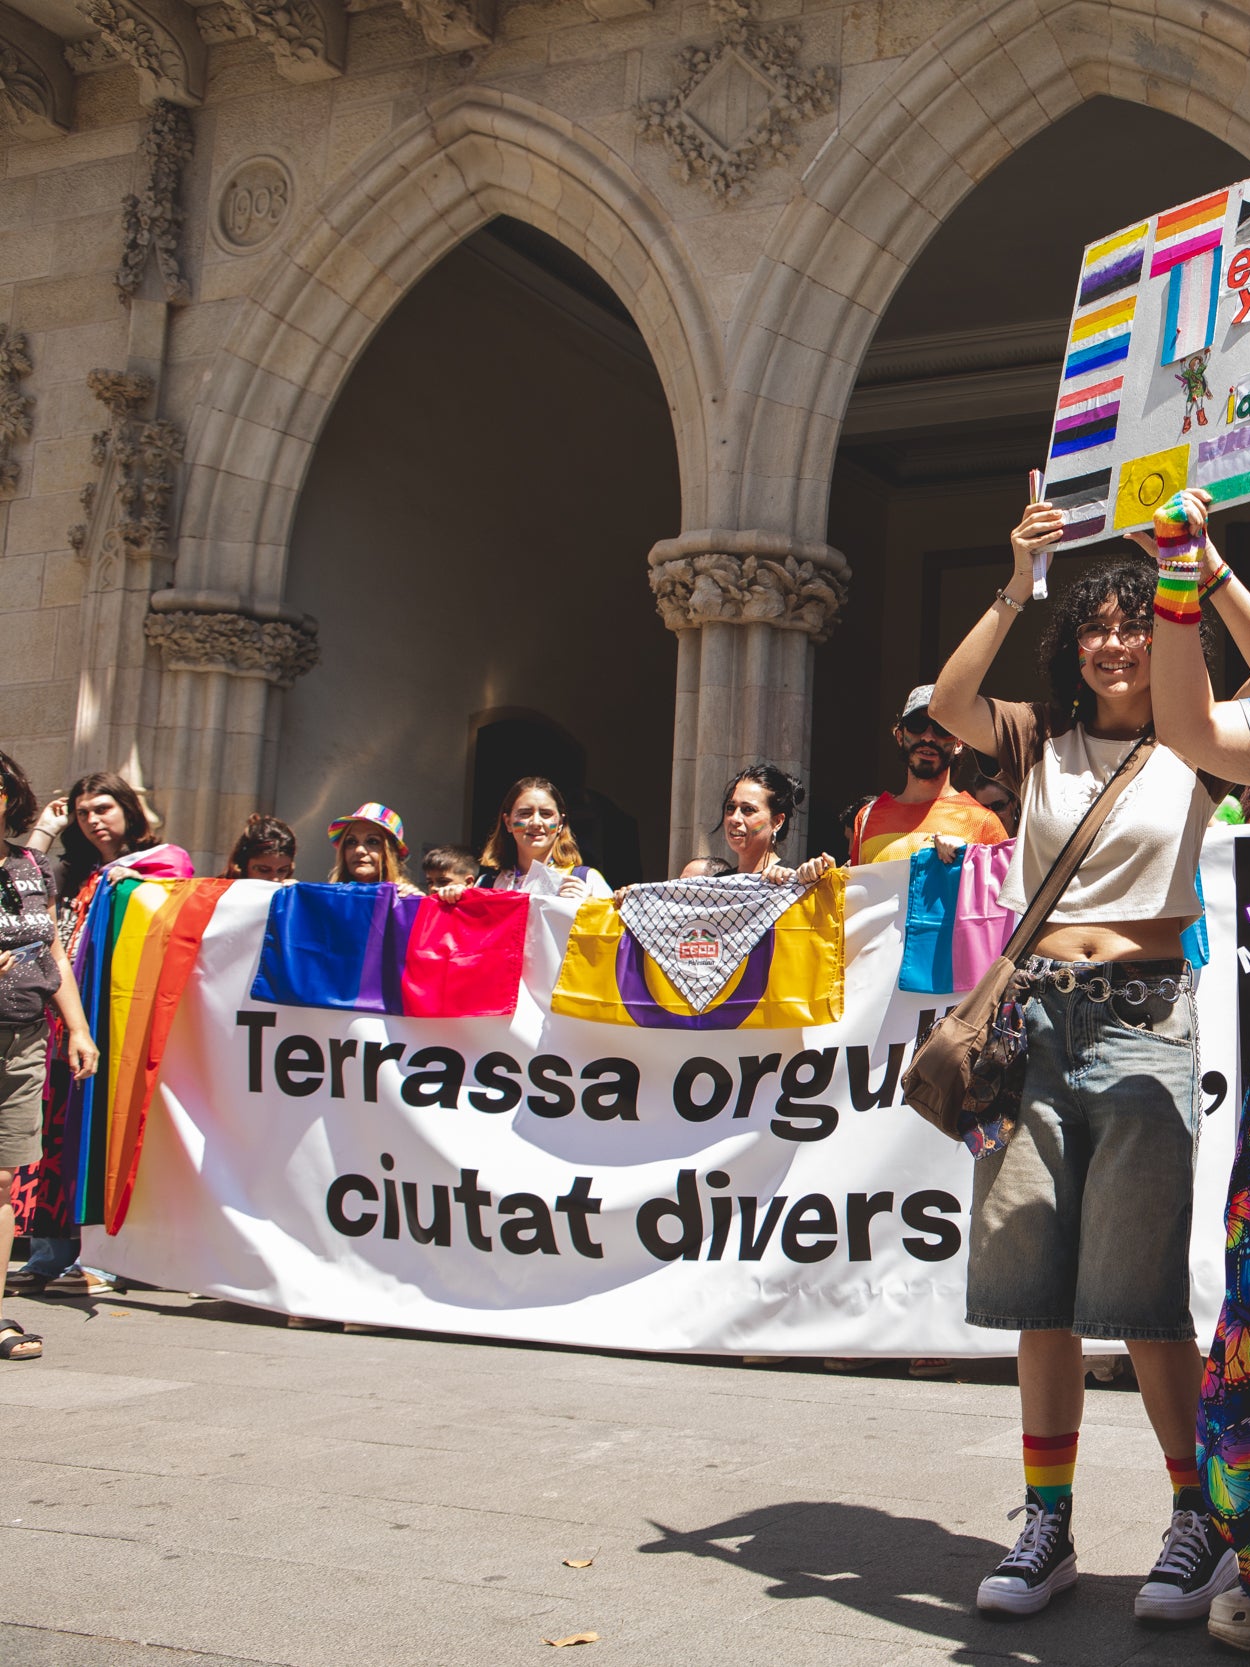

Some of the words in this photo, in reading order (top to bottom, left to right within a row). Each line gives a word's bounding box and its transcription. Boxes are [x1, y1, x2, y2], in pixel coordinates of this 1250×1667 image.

[228, 180, 288, 234] 1903
[236, 1010, 641, 1122] Terrassa
[326, 1152, 604, 1259] ciutat
[636, 1169, 972, 1264] divers
